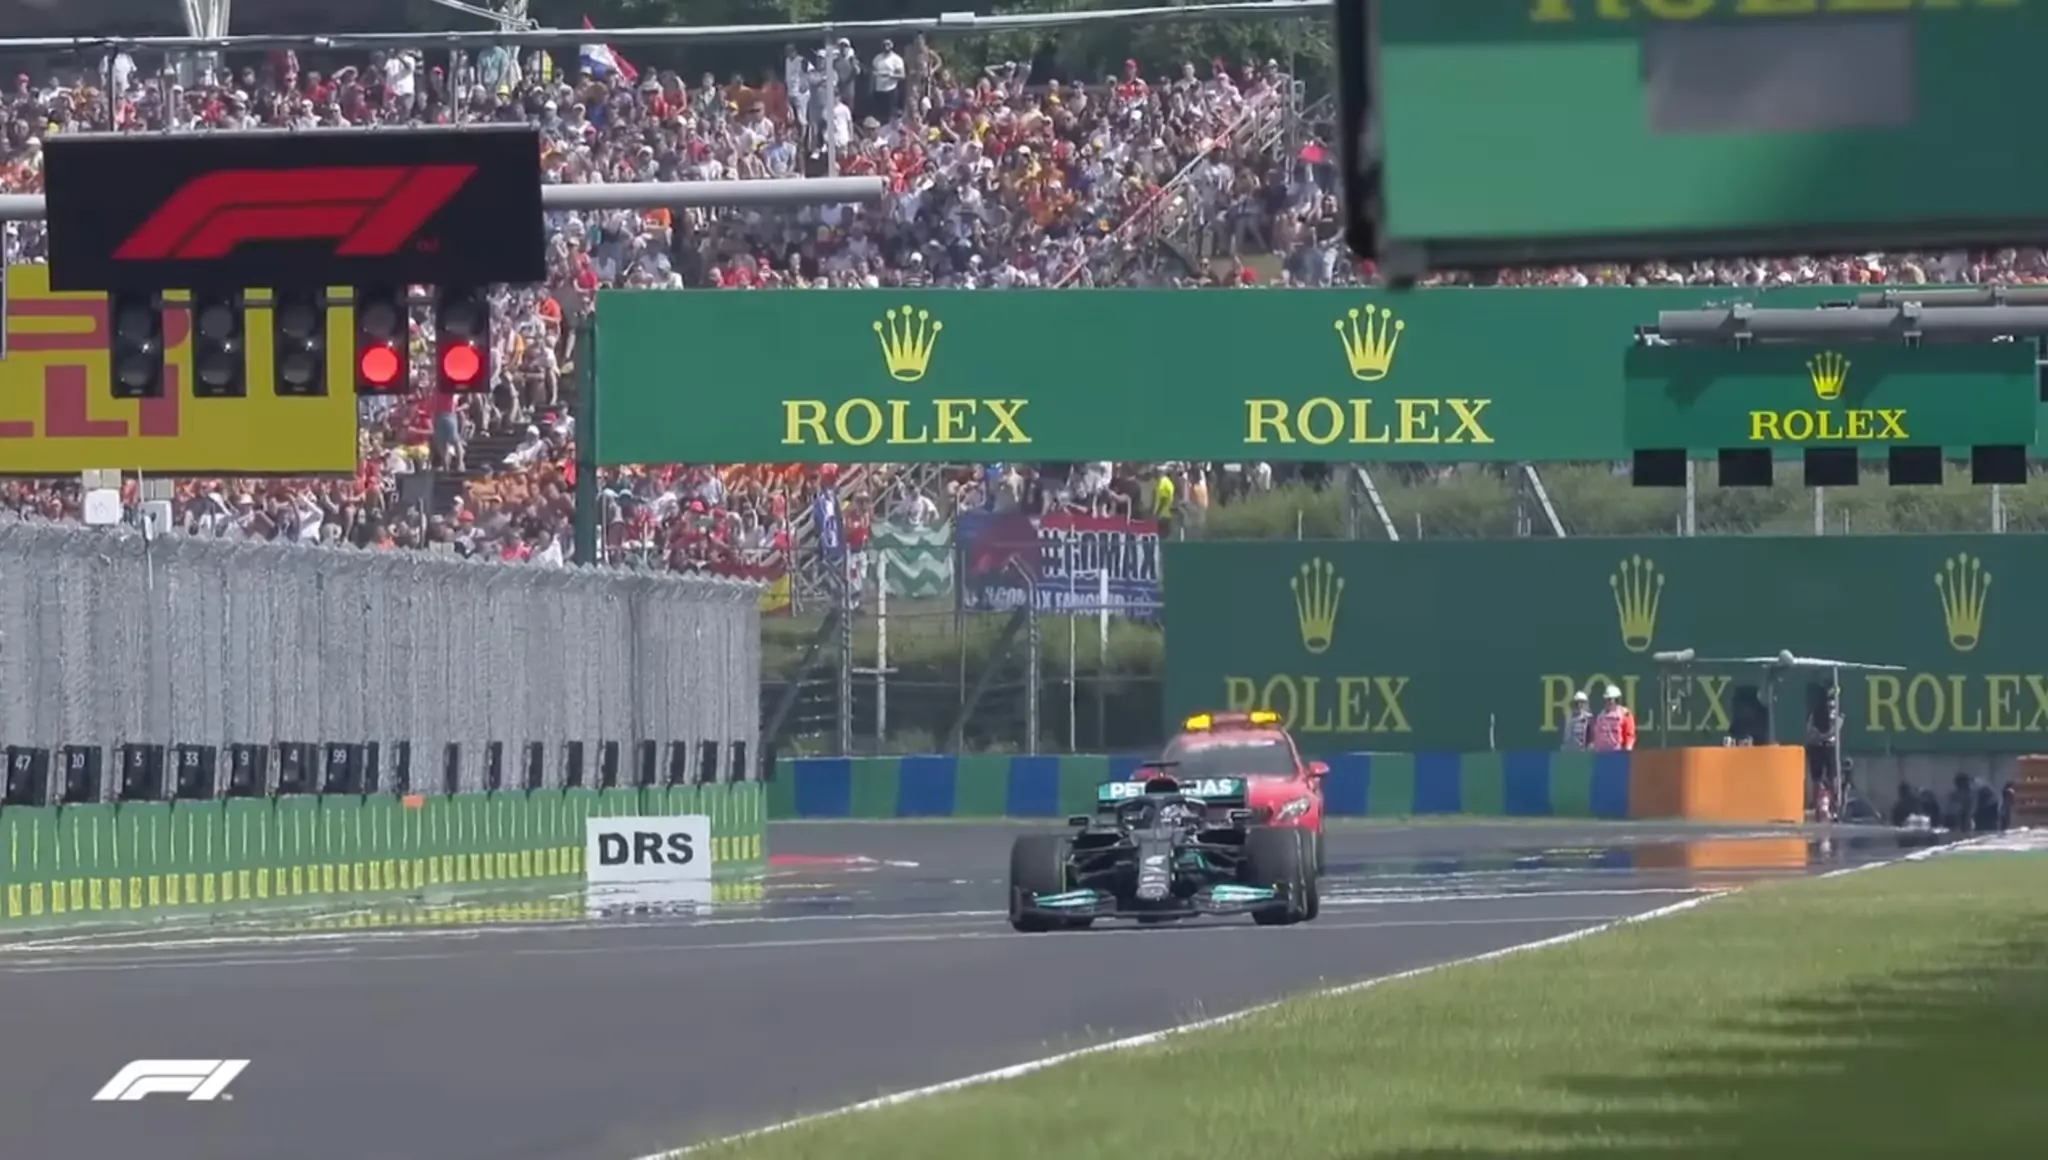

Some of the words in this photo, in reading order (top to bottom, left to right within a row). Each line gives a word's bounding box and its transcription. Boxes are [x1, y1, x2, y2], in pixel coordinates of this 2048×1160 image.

[111, 165, 478, 260] F1
[781, 398, 1032, 445] ROLEX
[1244, 397, 1495, 444] ROLEX
[1749, 409, 1909, 440] ROLEX
[1224, 674, 1412, 733] ROLEX
[15, 754, 32, 771] 47
[72, 753, 85, 769] 10
[185, 751, 199, 766] 33
[289, 750, 298, 763] 4
[333, 750, 347, 764] 99
[599, 831, 694, 865] DRS
